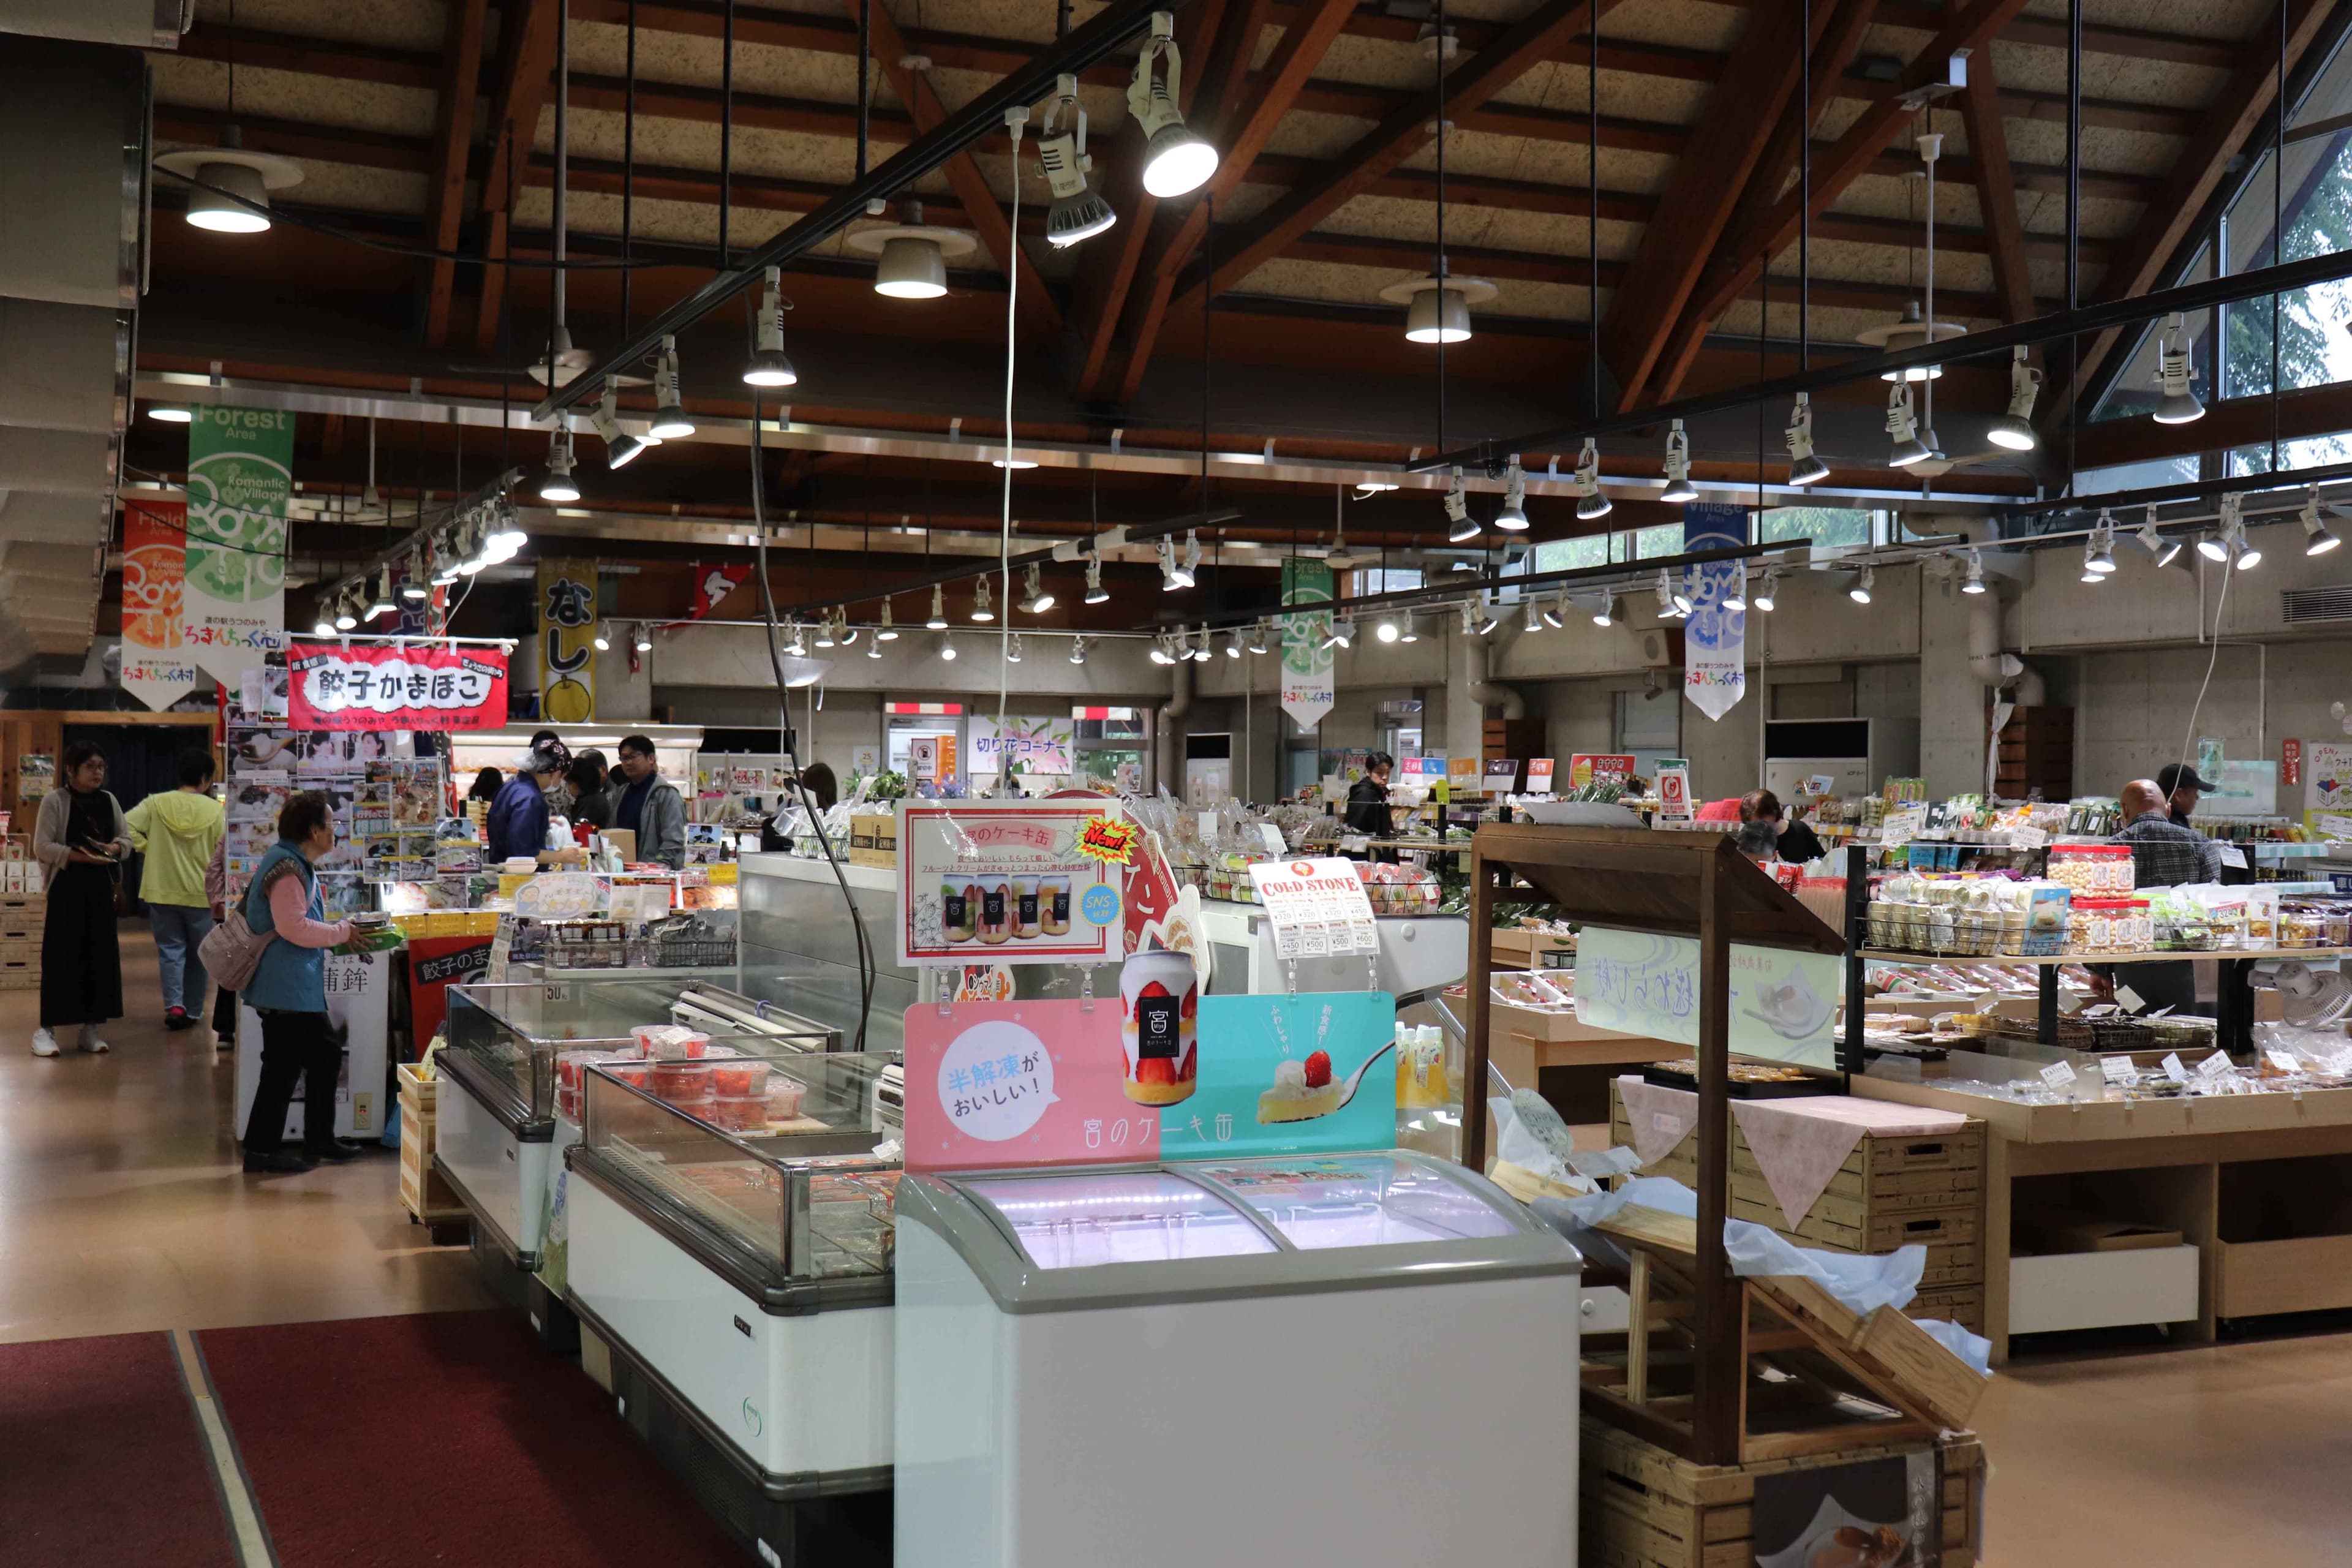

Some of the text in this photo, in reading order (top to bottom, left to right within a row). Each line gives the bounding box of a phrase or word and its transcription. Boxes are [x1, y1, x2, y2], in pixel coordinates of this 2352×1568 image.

[198, 407, 285, 429] Forest
[225, 428, 256, 440] Area
[228, 475, 285, 489] Romantic
[244, 489, 285, 502] Village
[205, 616, 266, 626] 道の駅うつのみや
[546, 578, 593, 673] なし
[318, 670, 481, 701] 餃子かまぼこ
[976, 737, 1066, 753] 切り花コーナー
[1084, 827, 1127, 851] New!
[1262, 876, 1359, 897] COLD STONE
[422, 949, 492, 981] 餃子のま
[547, 987, 562, 1000] 50
[948, 1051, 1039, 1095] 半解凍が
[954, 1077, 1040, 1117] おいしい!
[1084, 1112, 1234, 1149] 宮のケーキ缶
